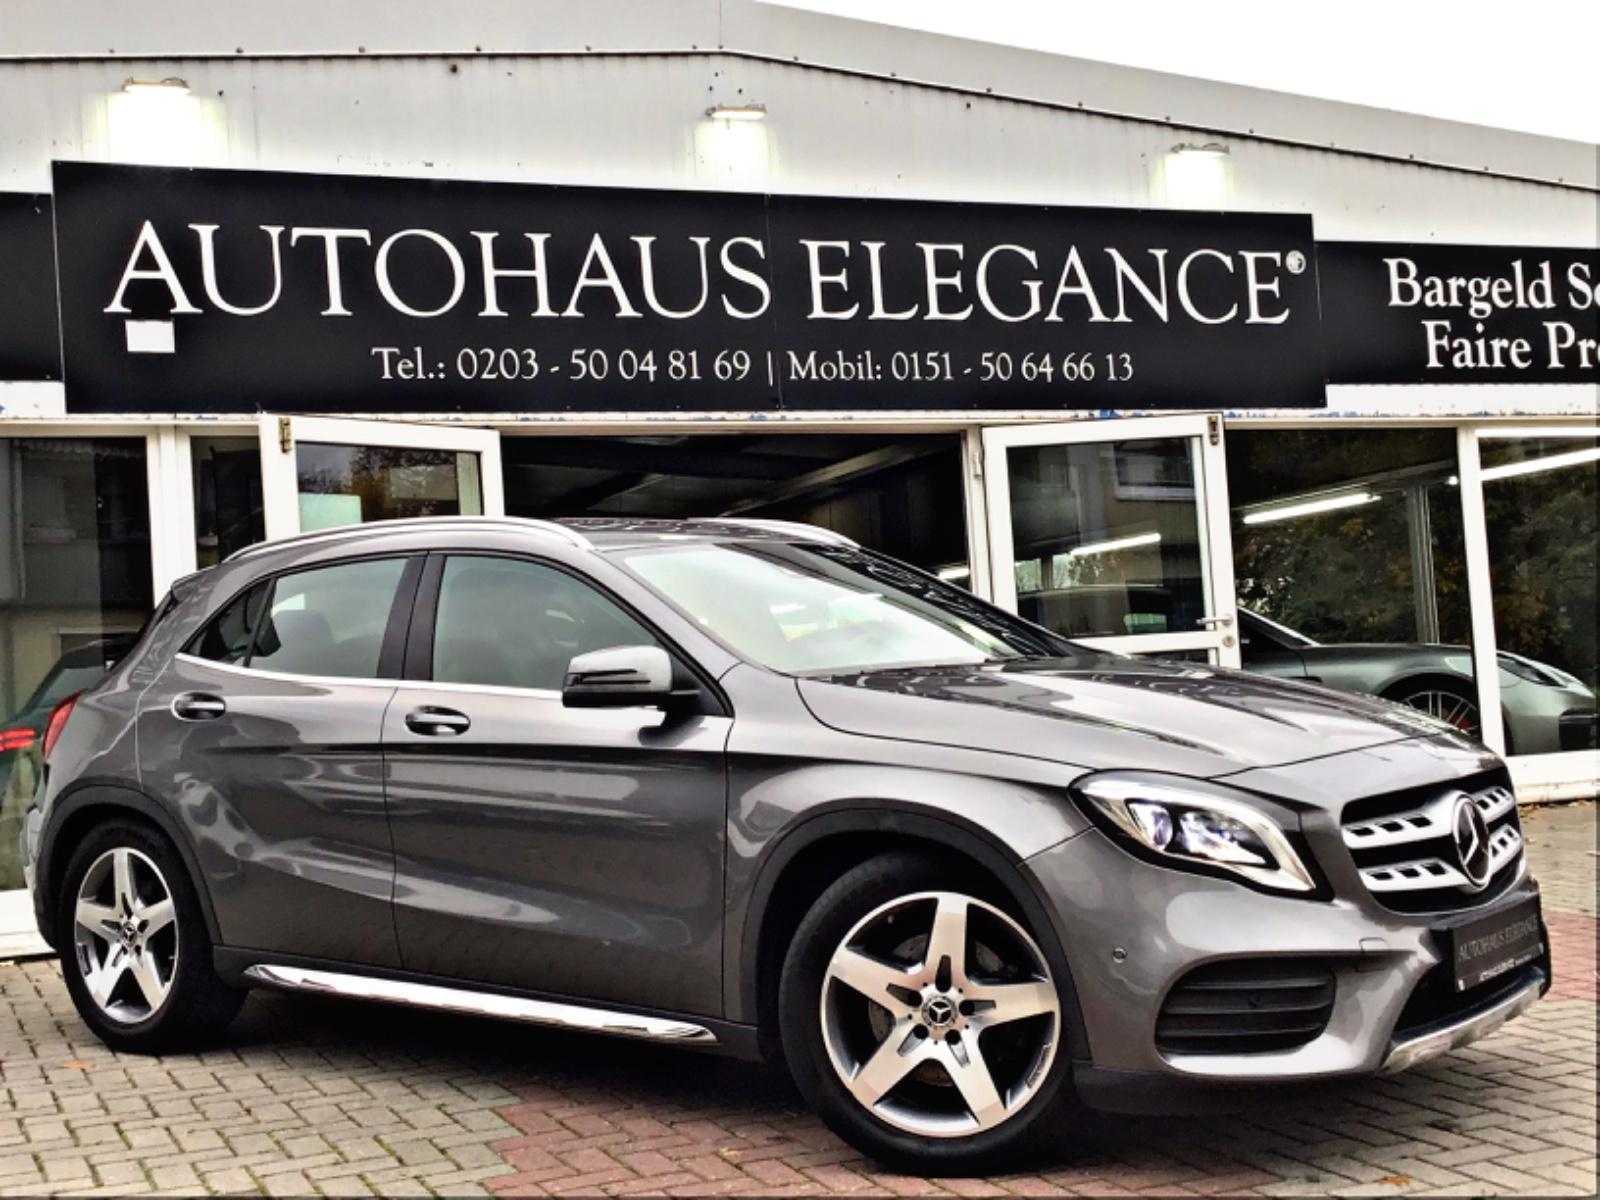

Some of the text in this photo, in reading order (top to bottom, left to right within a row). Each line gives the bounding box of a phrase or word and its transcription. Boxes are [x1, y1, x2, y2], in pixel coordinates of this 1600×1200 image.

[104, 219, 771, 320] AUTOHAUS
[1382, 257, 1557, 319] Bargeld
[371, 346, 446, 380] Tel.:
[456, 347, 539, 380] 0203
[569, 348, 609, 380] 50
[618, 349, 658, 382] 04
[668, 350, 702, 381] 81
[713, 349, 751, 381] 69
[786, 350, 882, 381] Mobil:
[891, 351, 953, 381] 0151
[980, 352, 1013, 381] 50
[1021, 352, 1054, 383] 64
[1062, 352, 1095, 381] 66
[1105, 352, 1134, 381] 13
[1421, 319, 1600, 369] Faire Pr
